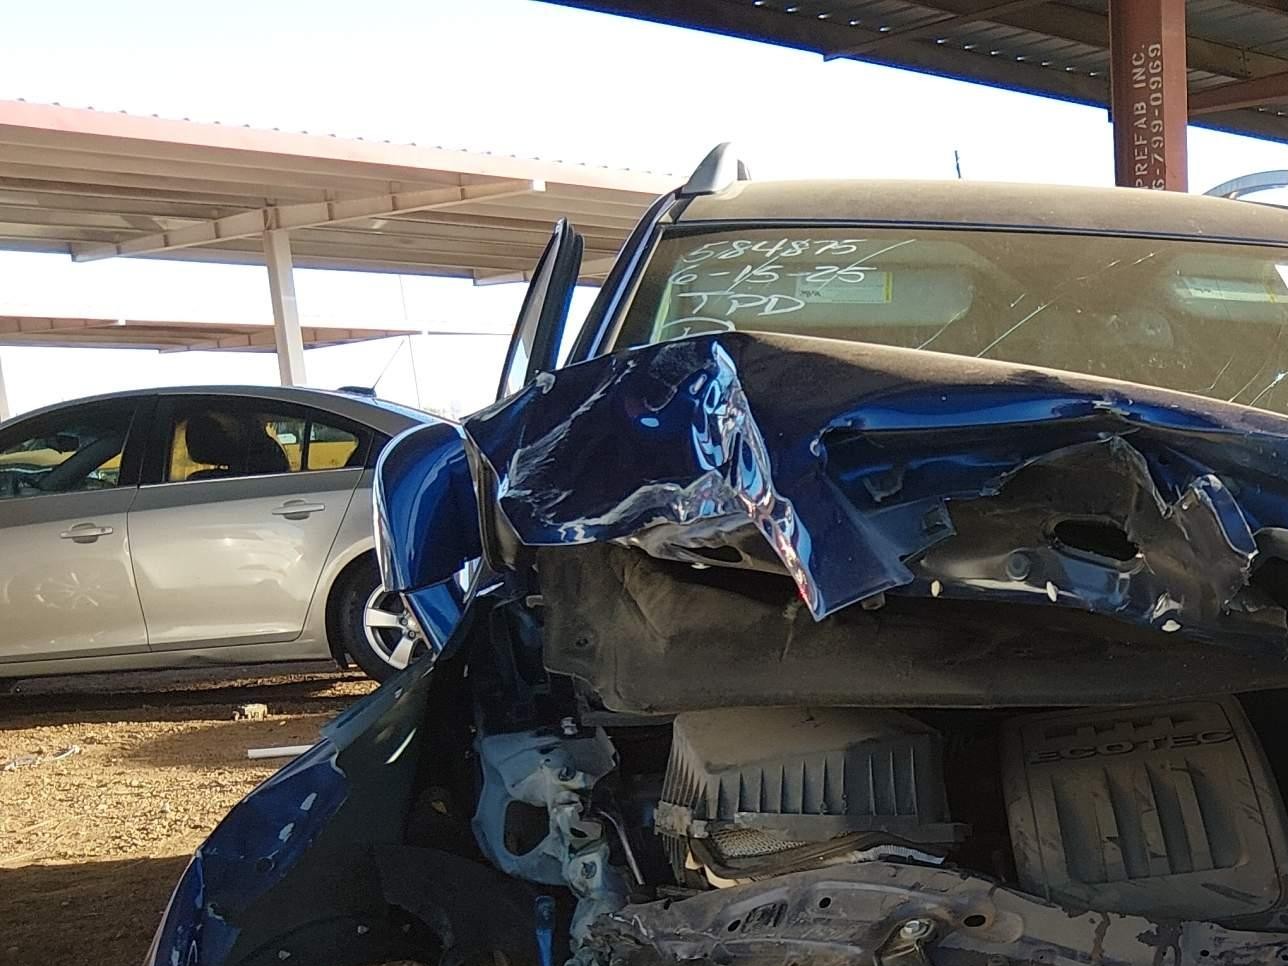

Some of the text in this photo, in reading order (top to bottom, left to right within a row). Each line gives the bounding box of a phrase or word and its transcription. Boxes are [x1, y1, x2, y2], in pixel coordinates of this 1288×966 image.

[1131, 44, 1148, 190] PREFAB INC.
[1024, 729, 1237, 766] ECOTEC
